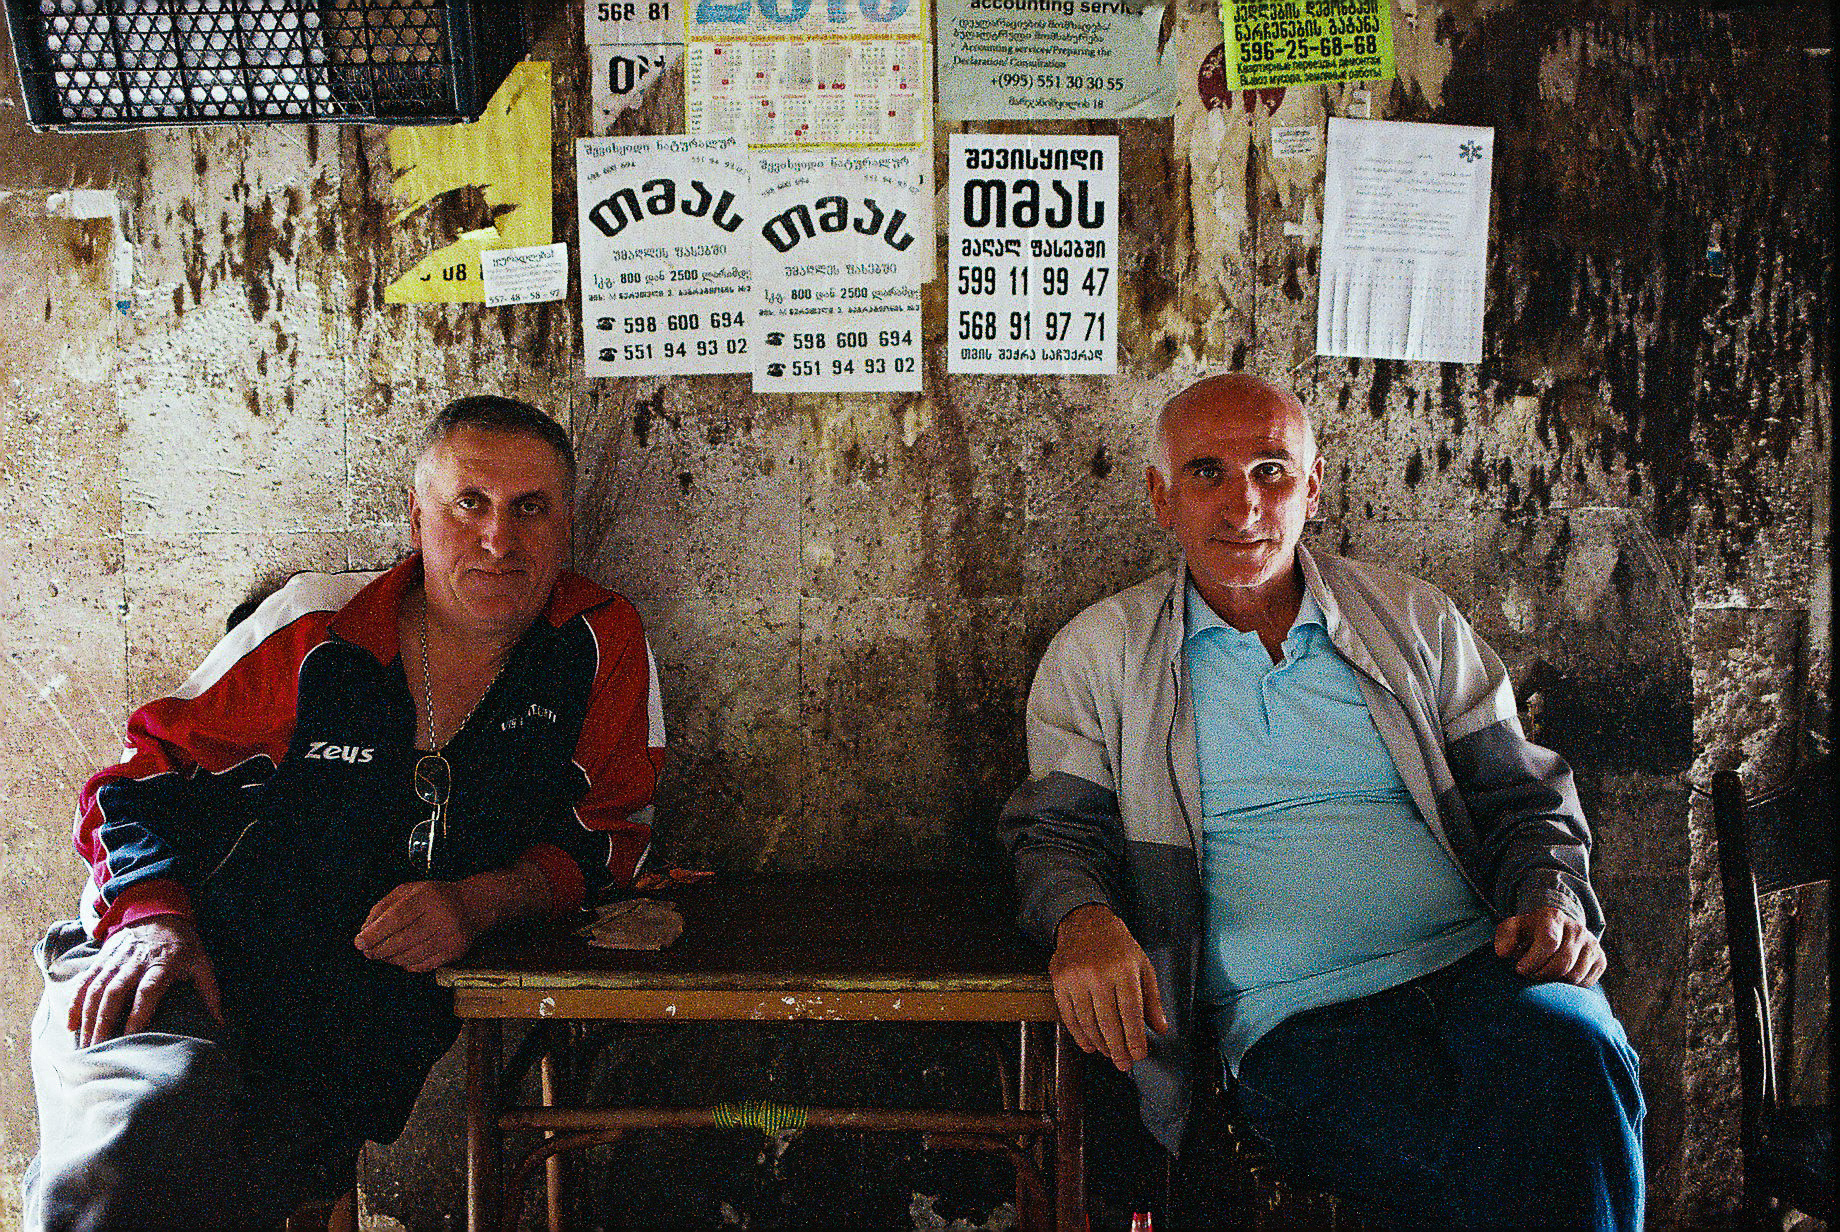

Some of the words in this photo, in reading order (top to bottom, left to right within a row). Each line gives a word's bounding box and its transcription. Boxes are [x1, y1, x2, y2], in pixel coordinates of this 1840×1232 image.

[598, 3, 634, 22] 568
[649, 3, 669, 21] 81
[970, 0, 1074, 15] accounting
[1235, 20, 1322, 41] ნარჩენების
[1329, 15, 1379, 35] გატანა
[961, 43, 1013, 54] Accounting
[1097, 46, 1112, 56] the
[1240, 34, 1376, 62] 596-25-68-68
[991, 73, 1034, 89] +(995)
[1037, 75, 1060, 88] 551
[1066, 76, 1083, 90] 30
[1086, 77, 1103, 90] 30
[1107, 78, 1124, 90] 55
[964, 148, 1104, 170] შევისყიდი
[589, 178, 744, 237] თმას
[964, 179, 1104, 229] თმას
[762, 196, 915, 253] თმას
[962, 239, 1021, 257] მაღალ
[1031, 239, 1105, 258] ფასებში
[620, 273, 641, 284] 800
[670, 270, 698, 282] 2500
[958, 266, 996, 295] 599
[1010, 266, 1028, 296] 11
[1043, 267, 1068, 296] 99
[1082, 267, 1109, 296] 47
[791, 288, 811, 300] 800
[841, 287, 868, 299] 2500
[624, 316, 656, 334] 598
[668, 314, 699, 330] 600
[710, 311, 744, 329] 694
[959, 311, 996, 340] 568
[1010, 311, 1030, 340] 91
[1046, 312, 1072, 341] 97
[1084, 312, 1105, 341] 71
[624, 344, 652, 360] 551
[664, 342, 687, 358] 94
[697, 340, 718, 356] 93
[726, 338, 748, 354] 02
[793, 333, 826, 350] 598
[837, 332, 867, 348] 600
[879, 330, 912, 347] 694
[961, 348, 992, 360] თმის
[1042, 348, 1103, 362] საჩუქრად
[792, 360, 820, 376] 551
[832, 359, 855, 375] 94
[865, 358, 886, 373] 93
[894, 357, 914, 372] 02
